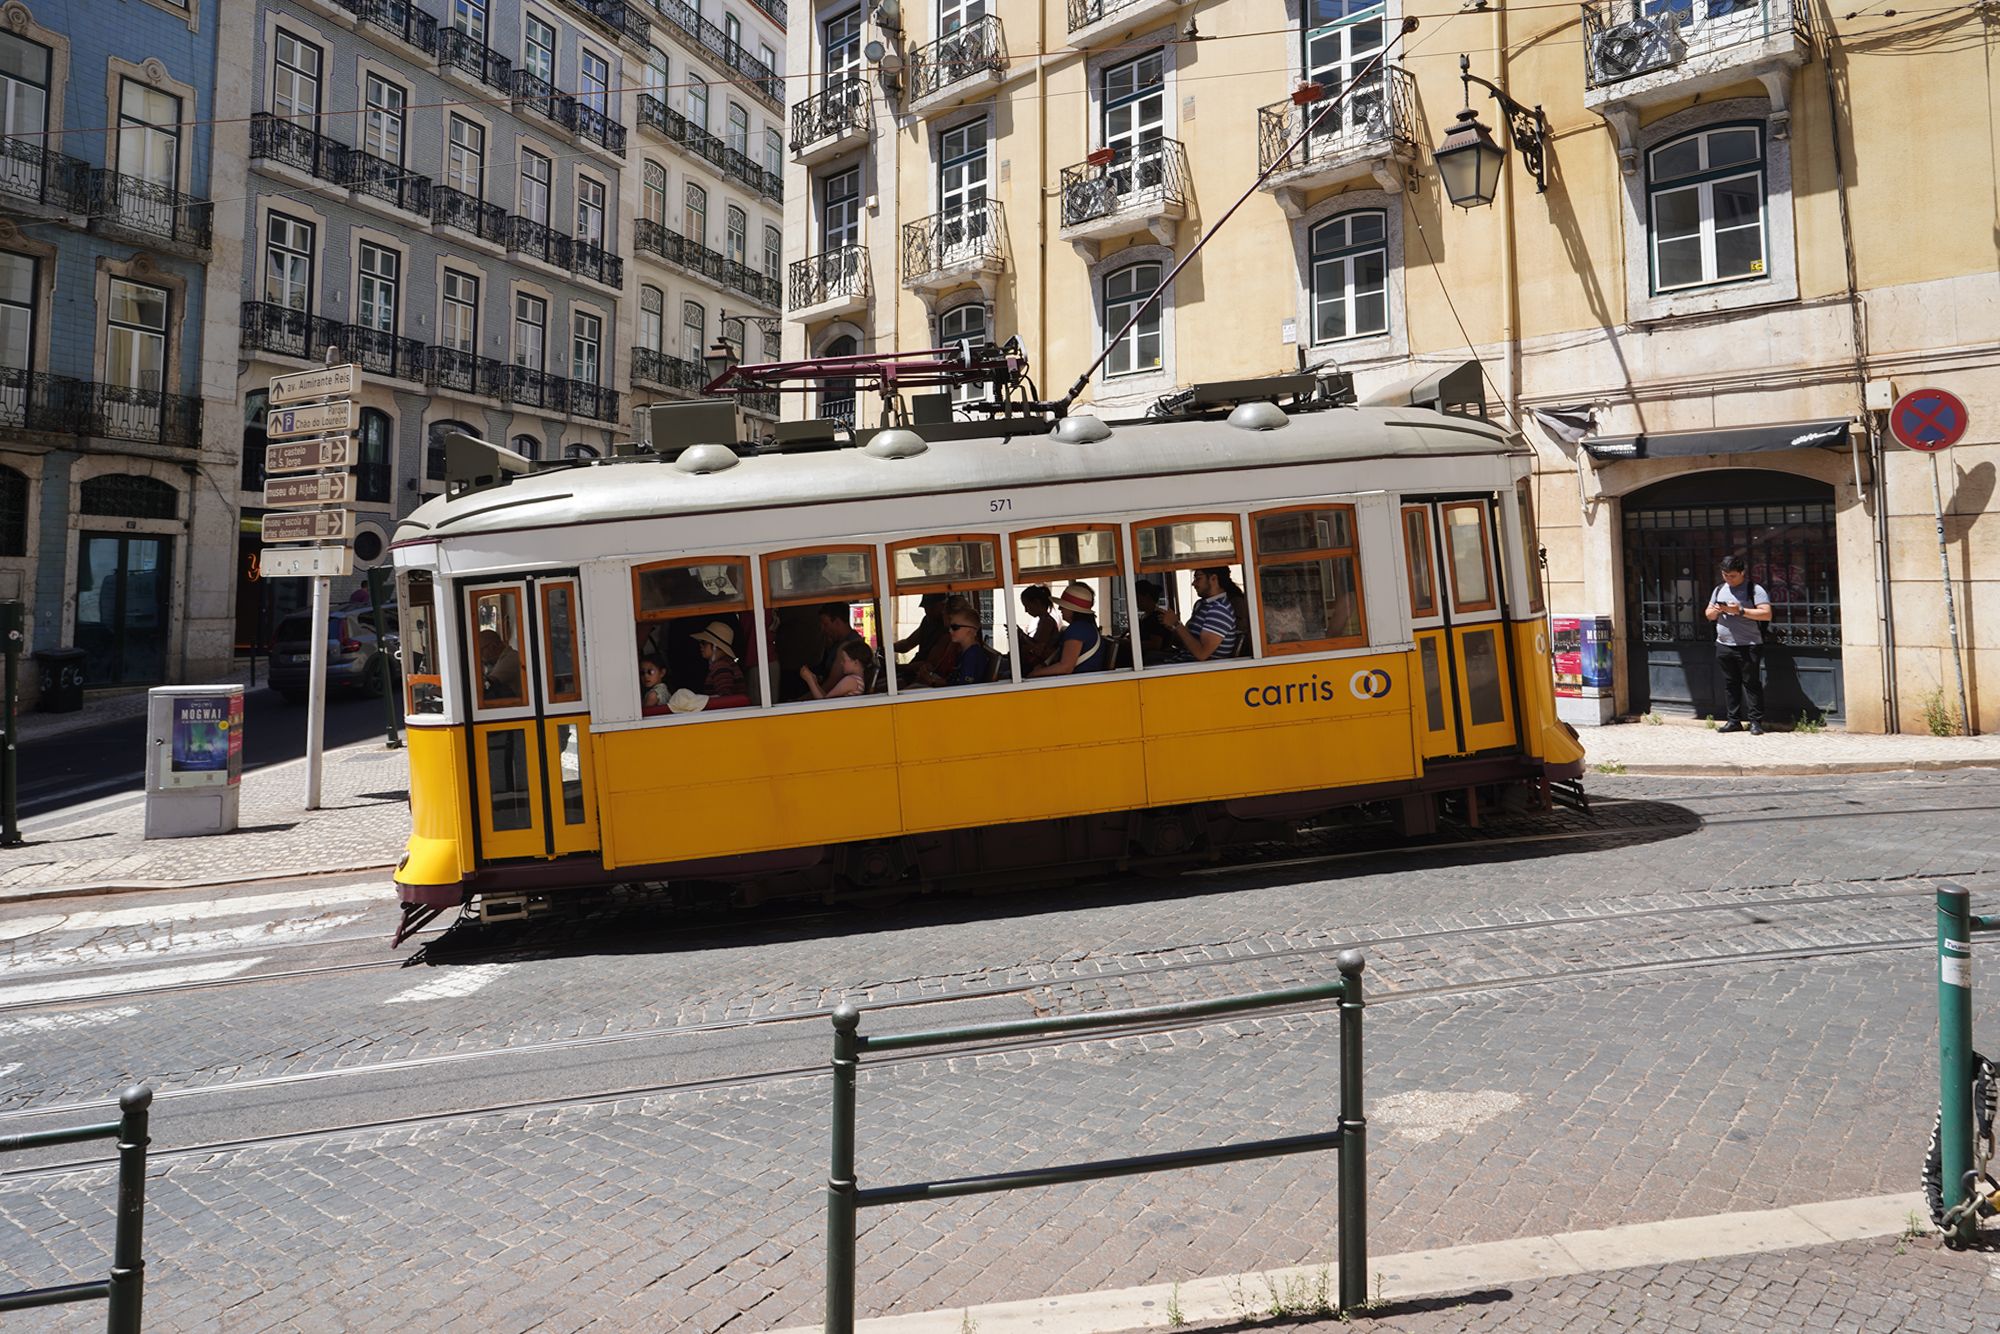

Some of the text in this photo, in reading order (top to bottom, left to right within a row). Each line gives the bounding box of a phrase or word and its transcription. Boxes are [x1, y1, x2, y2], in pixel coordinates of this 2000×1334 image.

[299, 376, 333, 390] Almirante
[334, 372, 350, 384] Reis
[328, 406, 348, 416] Parque
[312, 418, 320, 427] do
[321, 416, 347, 426] Loureiro
[284, 447, 306, 457] castelo
[269, 460, 277, 468] de
[267, 483, 318, 497] museu do Aljube
[990, 498, 1012, 512] 571
[1244, 673, 1334, 708] carris
[181, 708, 222, 720] MOGWAI
